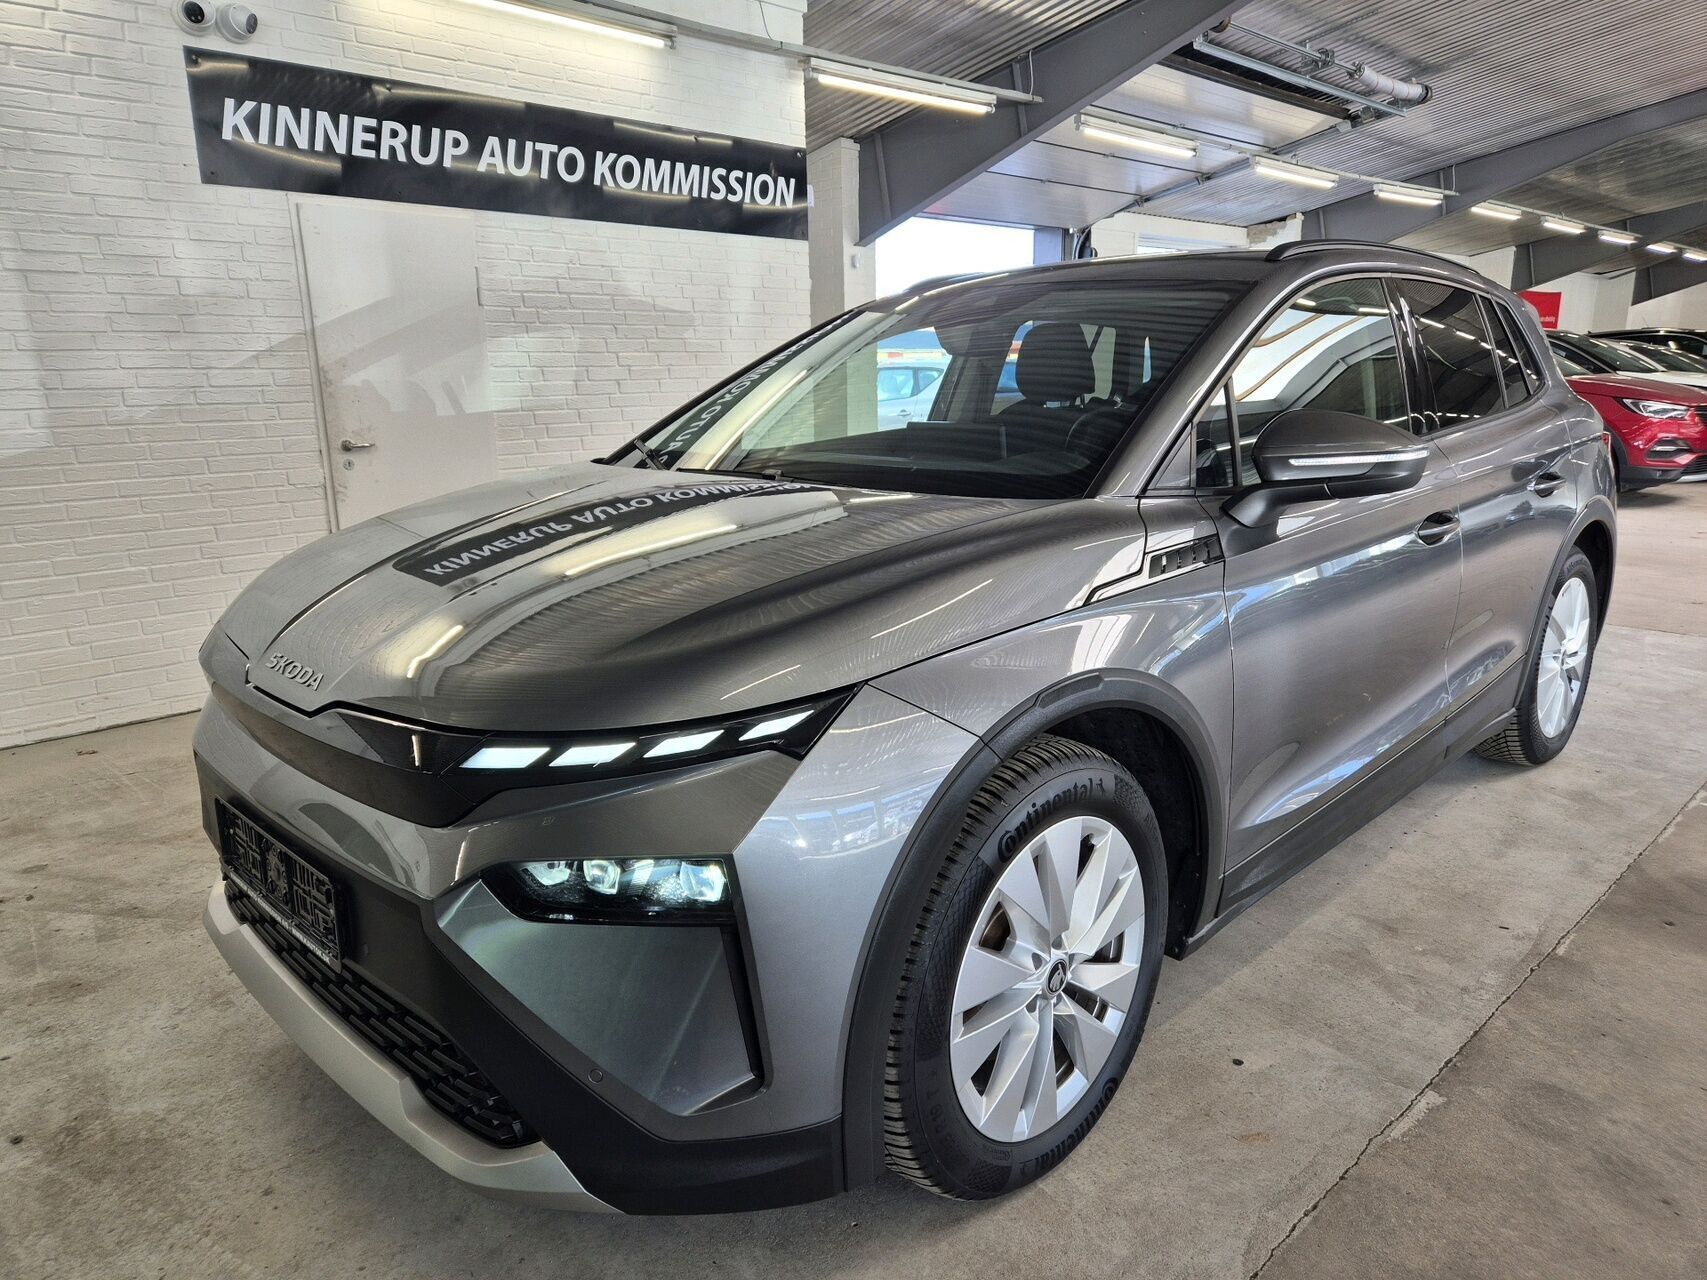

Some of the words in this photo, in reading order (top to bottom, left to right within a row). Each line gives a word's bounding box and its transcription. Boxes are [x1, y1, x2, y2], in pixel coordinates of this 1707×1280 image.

[221, 97, 470, 169] KINNERUP
[477, 135, 586, 184] AUTO
[592, 149, 796, 209] KOMMISSION
[998, 777, 1093, 863] Continental
